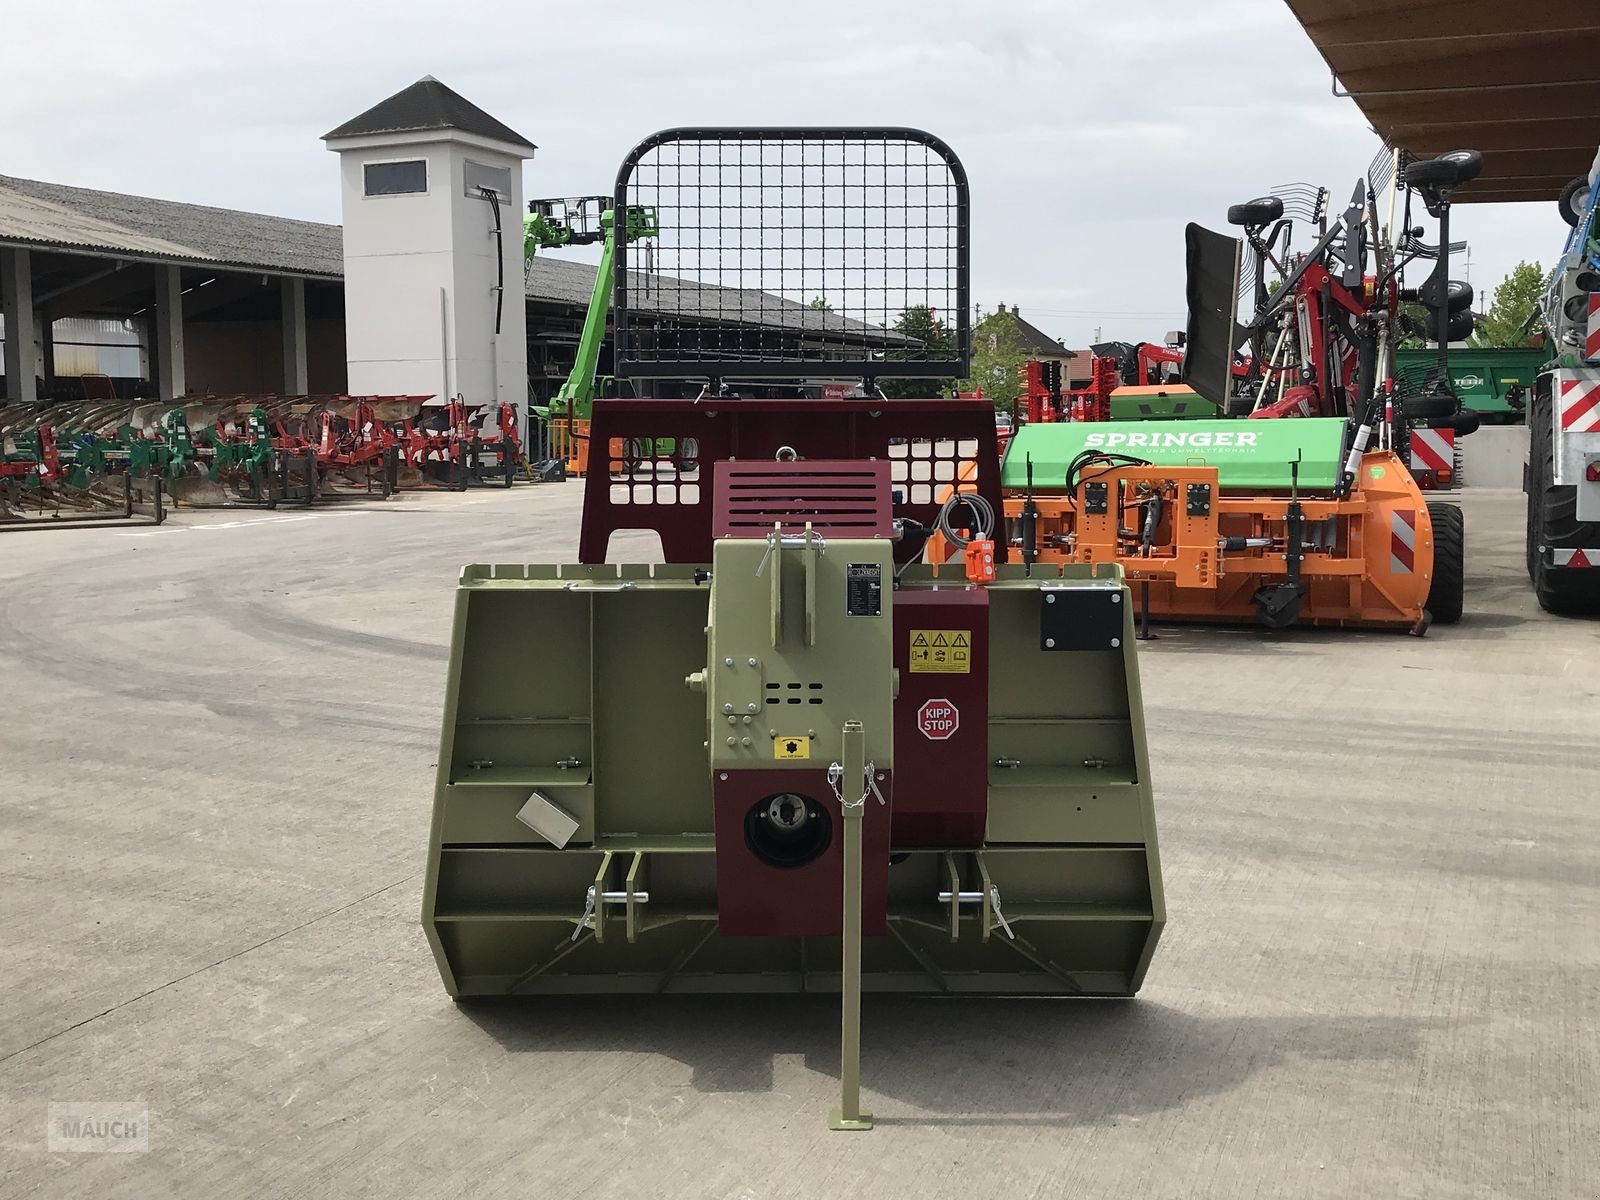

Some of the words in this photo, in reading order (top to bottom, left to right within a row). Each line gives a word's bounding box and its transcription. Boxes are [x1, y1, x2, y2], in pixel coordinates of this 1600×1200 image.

[1084, 431, 1258, 448] SPRINGER
[925, 708, 951, 719] KIPP
[924, 720, 953, 731] STOP
